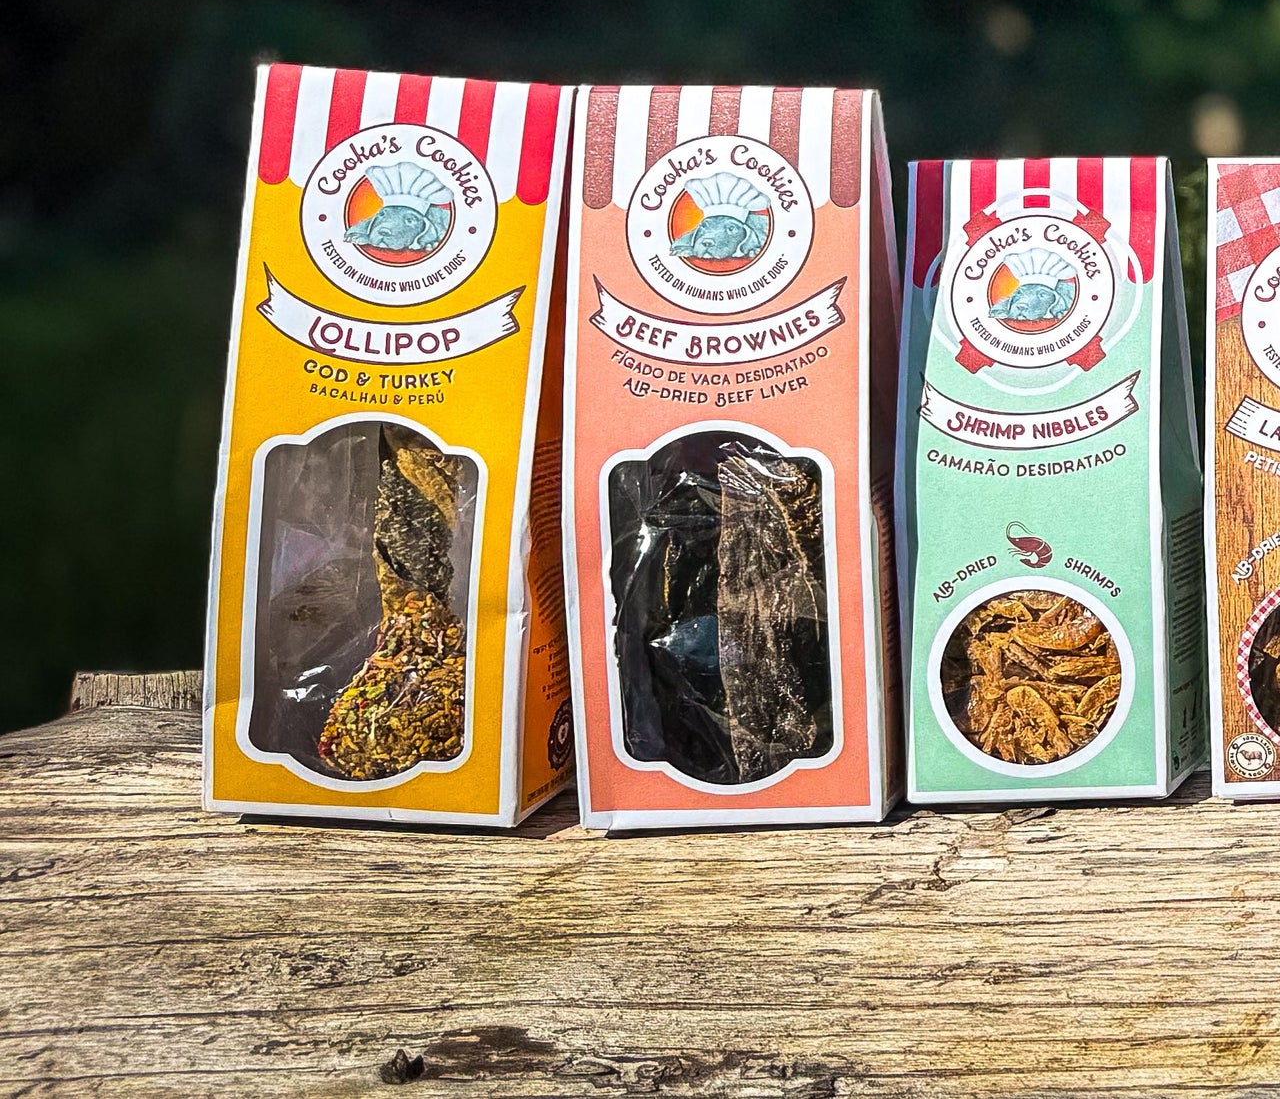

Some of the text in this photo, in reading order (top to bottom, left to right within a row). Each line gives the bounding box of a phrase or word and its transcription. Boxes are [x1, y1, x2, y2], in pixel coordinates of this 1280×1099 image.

[317, 135, 483, 209] Cooka's Cookies
[640, 144, 798, 213] Cooka's Cookies
[321, 239, 347, 270] TESTED
[343, 265, 357, 280] ON
[356, 273, 397, 292] HUMANS
[399, 281, 421, 293] WHO
[422, 269, 446, 288] LOVE
[964, 223, 1101, 280] Cooka's Cookies
[648, 254, 674, 283] TESTED
[671, 277, 685, 292] ON
[685, 285, 724, 301] HUMANS
[726, 286, 748, 301] WHO
[747, 276, 771, 294] LOVE
[308, 315, 460, 355] LOLLIPOP
[615, 309, 821, 360] BEEF BROWNIES
[970, 317, 992, 341] TESTED
[990, 336, 1001, 349] ON
[1001, 342, 1035, 356] HUMANS
[1036, 343, 1056, 355] WHO
[1055, 333, 1075, 350] LOVE
[303, 359, 454, 389] COD & TURKEY
[610, 346, 829, 386] FÍGADO DE VACA DESIDRATADO
[309, 383, 445, 405] BACALHAU & PERÚ
[623, 376, 809, 408] AIR-DRIED BEEF LIVER
[947, 405, 1109, 440] SHRIMP NIBBLES
[926, 443, 1127, 477] CAMARÃO DESIDRATADO
[932, 555, 1122, 603] AIR-DRIED SHRIMPS
